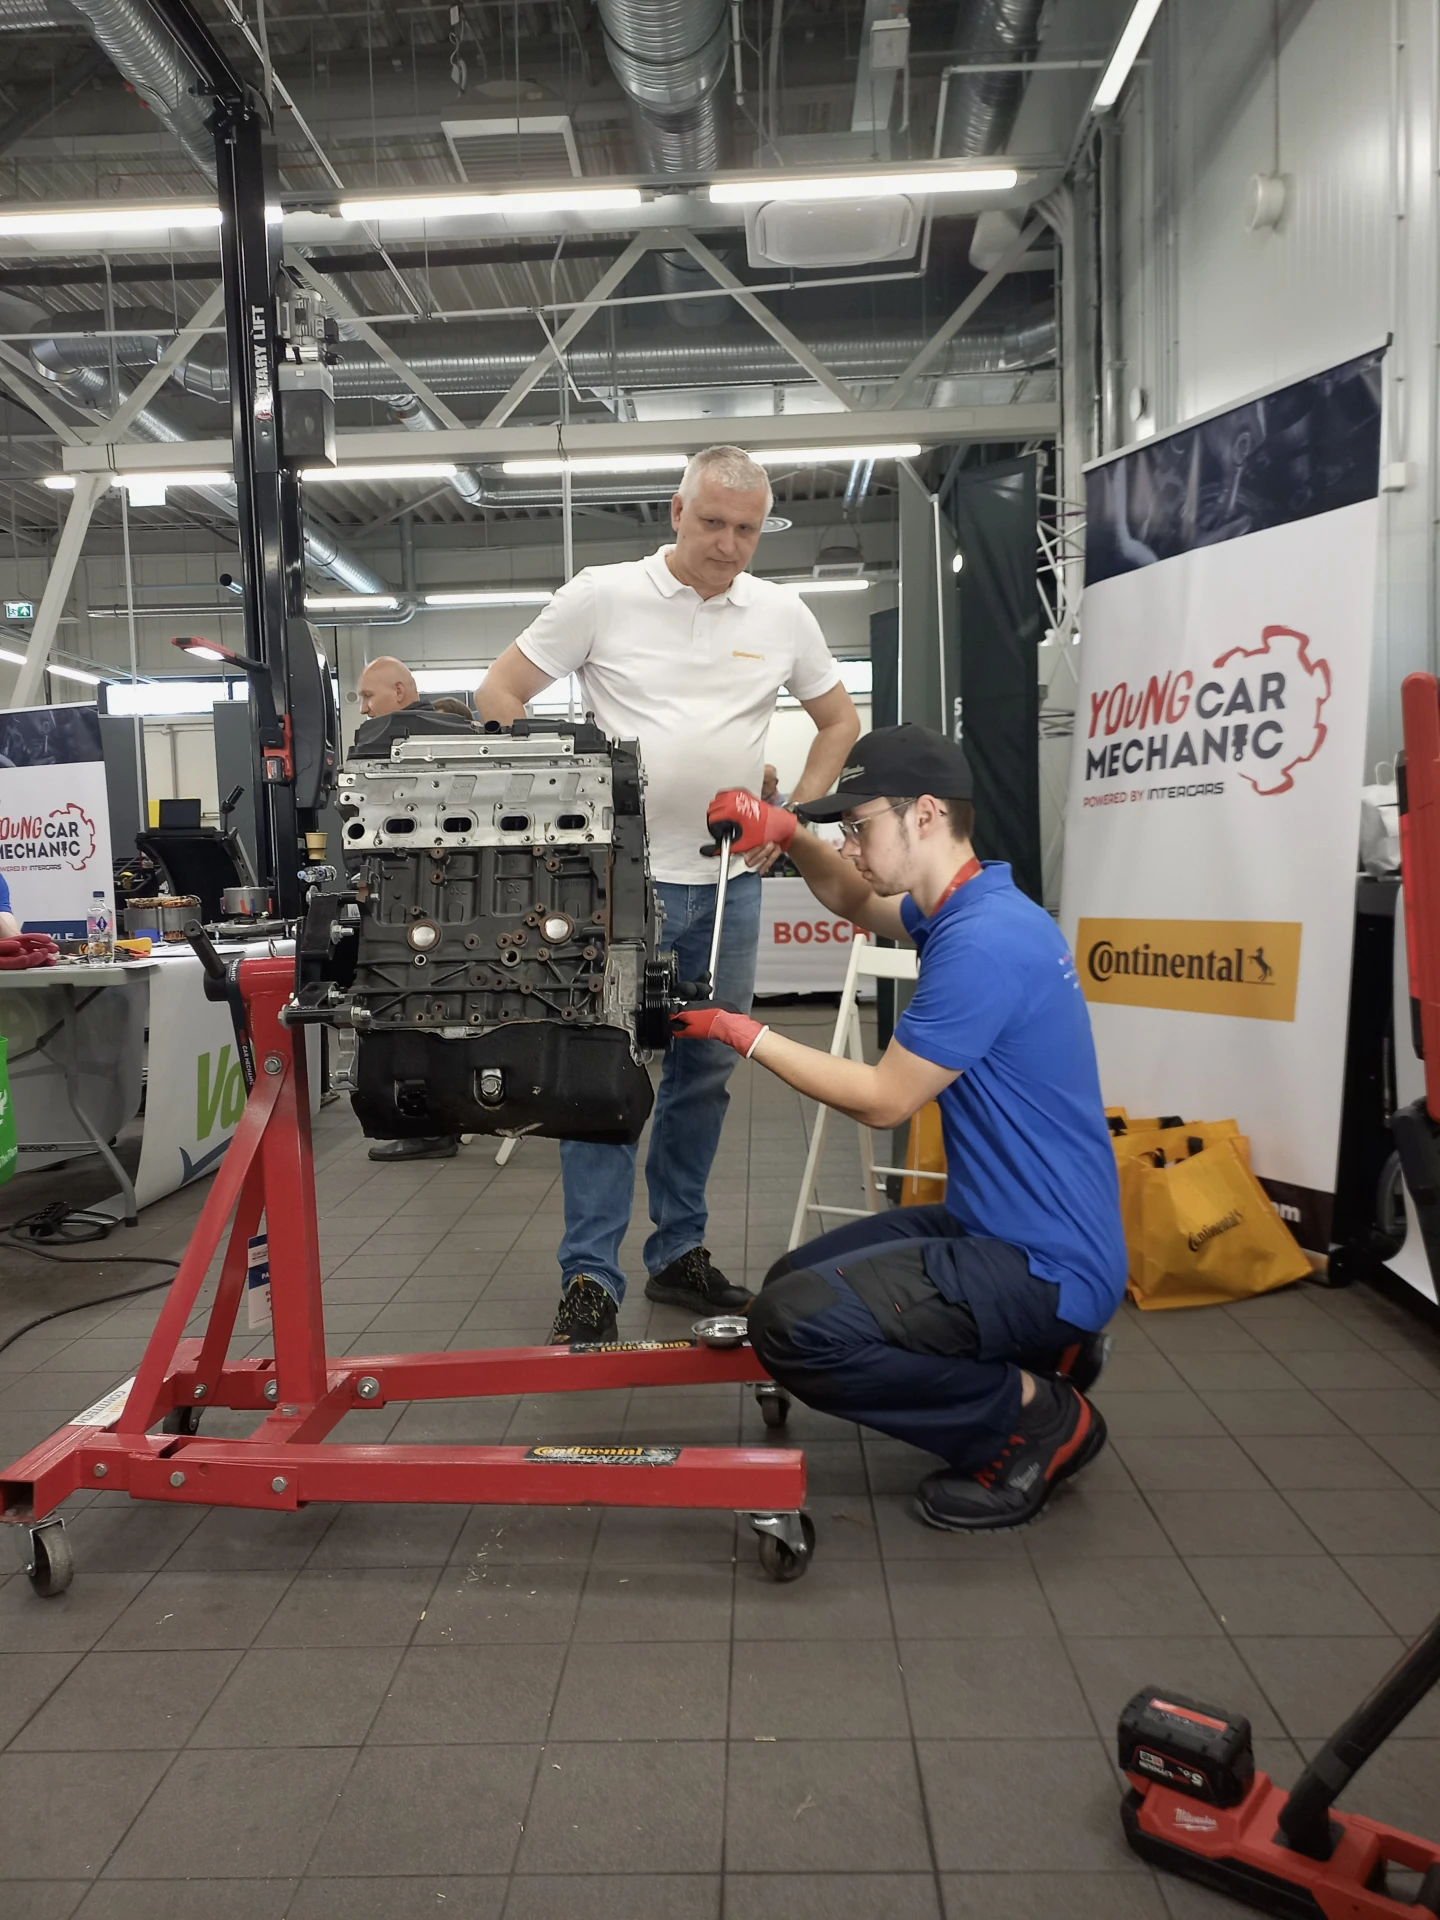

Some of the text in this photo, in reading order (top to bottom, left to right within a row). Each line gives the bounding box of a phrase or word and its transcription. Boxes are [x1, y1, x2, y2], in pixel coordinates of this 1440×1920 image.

[251, 305, 270, 405] OTARY LIFT
[1195, 672, 1286, 720] CAR
[1083, 782, 1225, 808] POWERED BY INTERCARS
[0, 815, 80, 841] OUNG CAR
[1087, 940, 1244, 982] Continental
